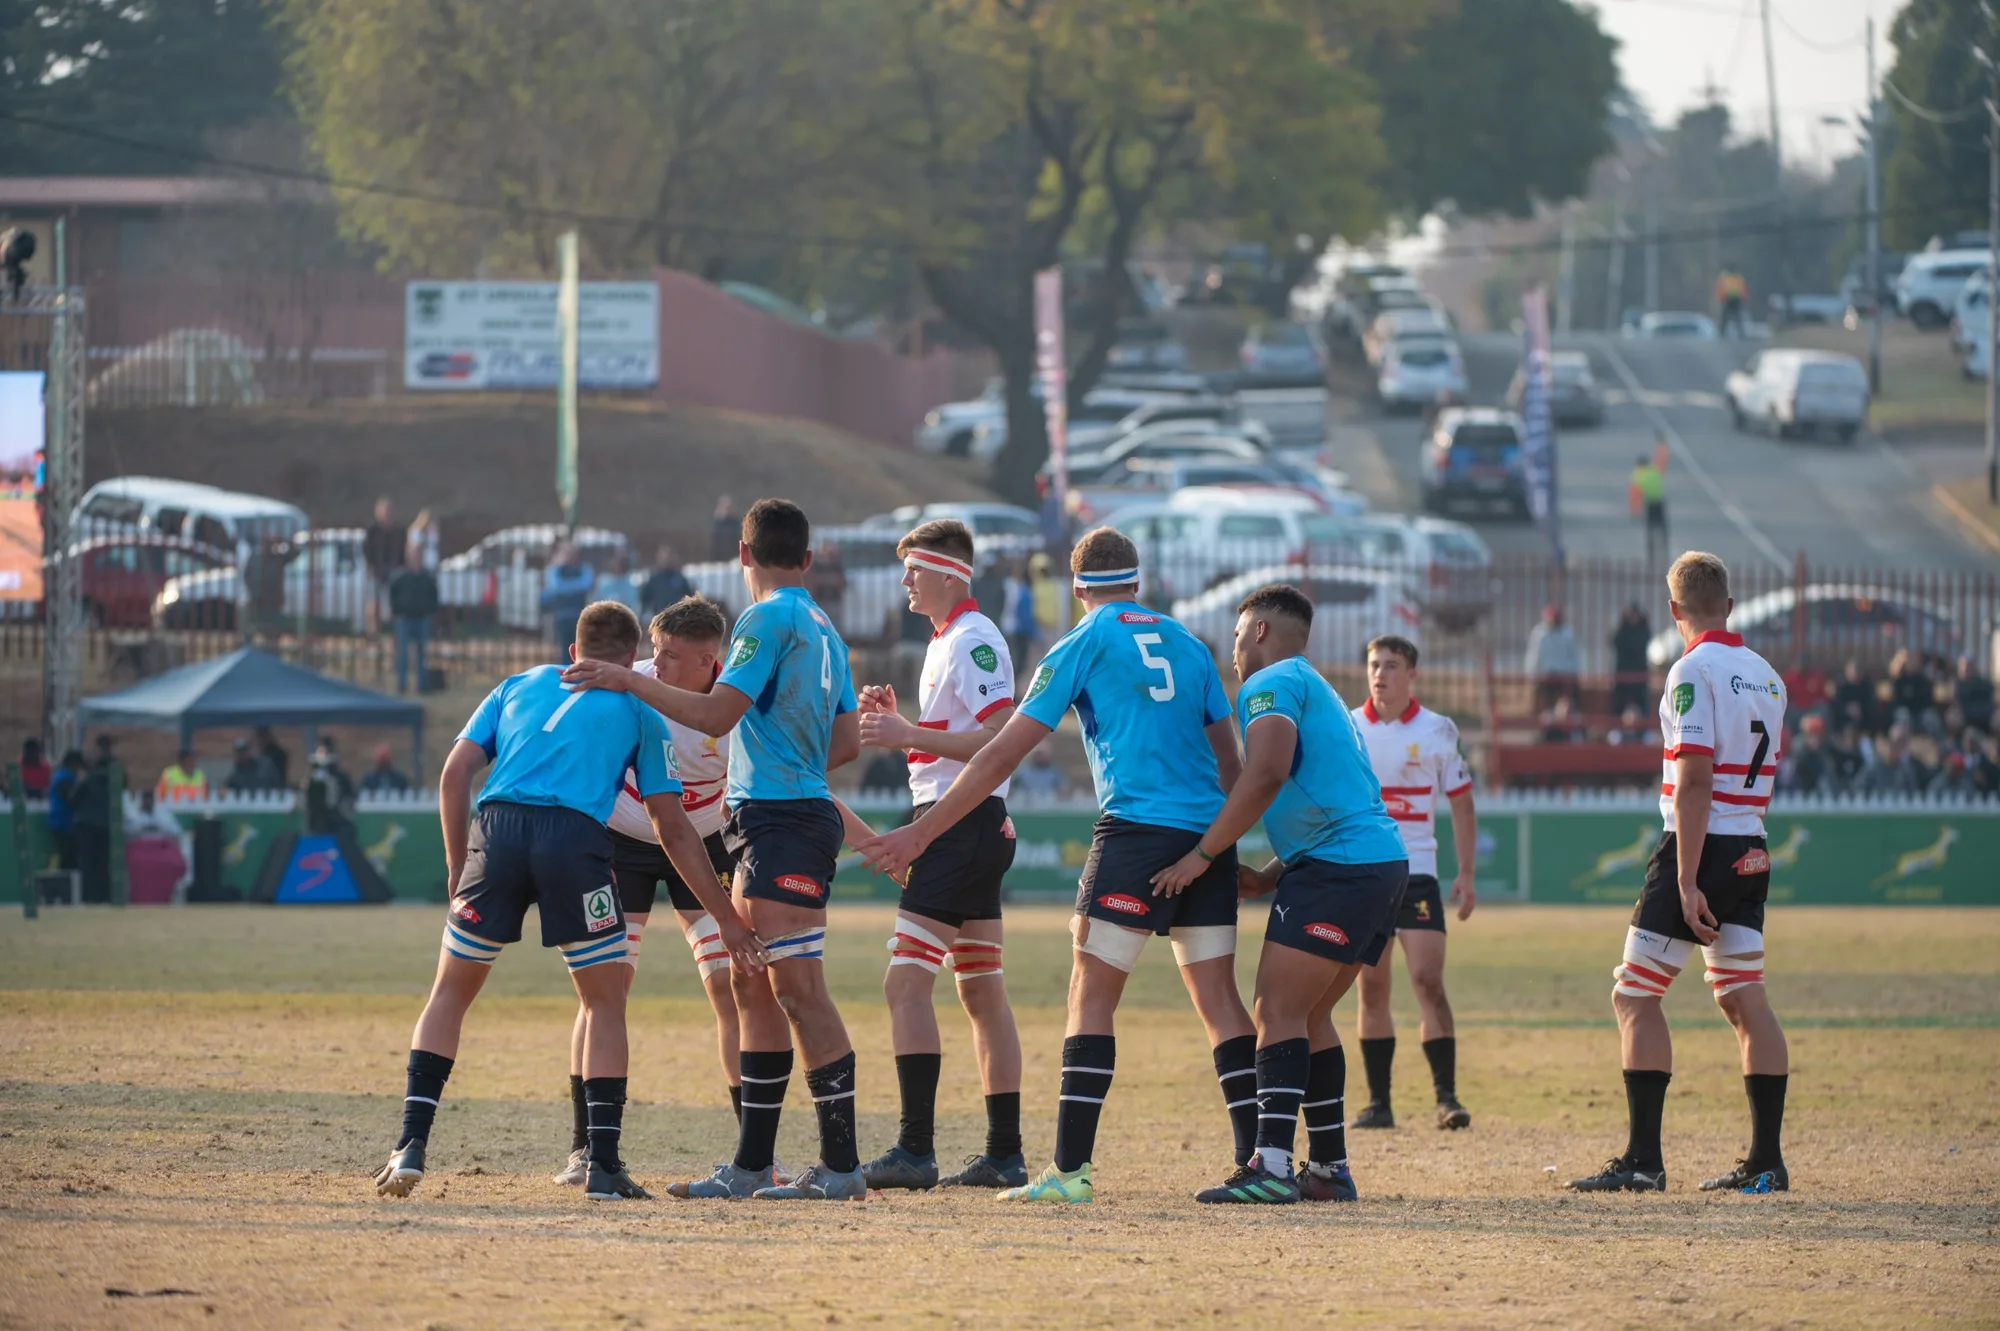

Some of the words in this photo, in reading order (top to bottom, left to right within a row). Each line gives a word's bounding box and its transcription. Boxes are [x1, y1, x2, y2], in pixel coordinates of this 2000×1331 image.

[820, 635, 832, 691] 4
[1132, 633, 1175, 702] 5
[1735, 682, 1768, 693] FIDELITY
[541, 681, 589, 733] 7
[1743, 720, 1770, 788] 7
[783, 877, 816, 894] OBARO
[1107, 896, 1141, 912] OBARO
[590, 917, 616, 931] SPAR
[1312, 925, 1342, 942] OBARO
